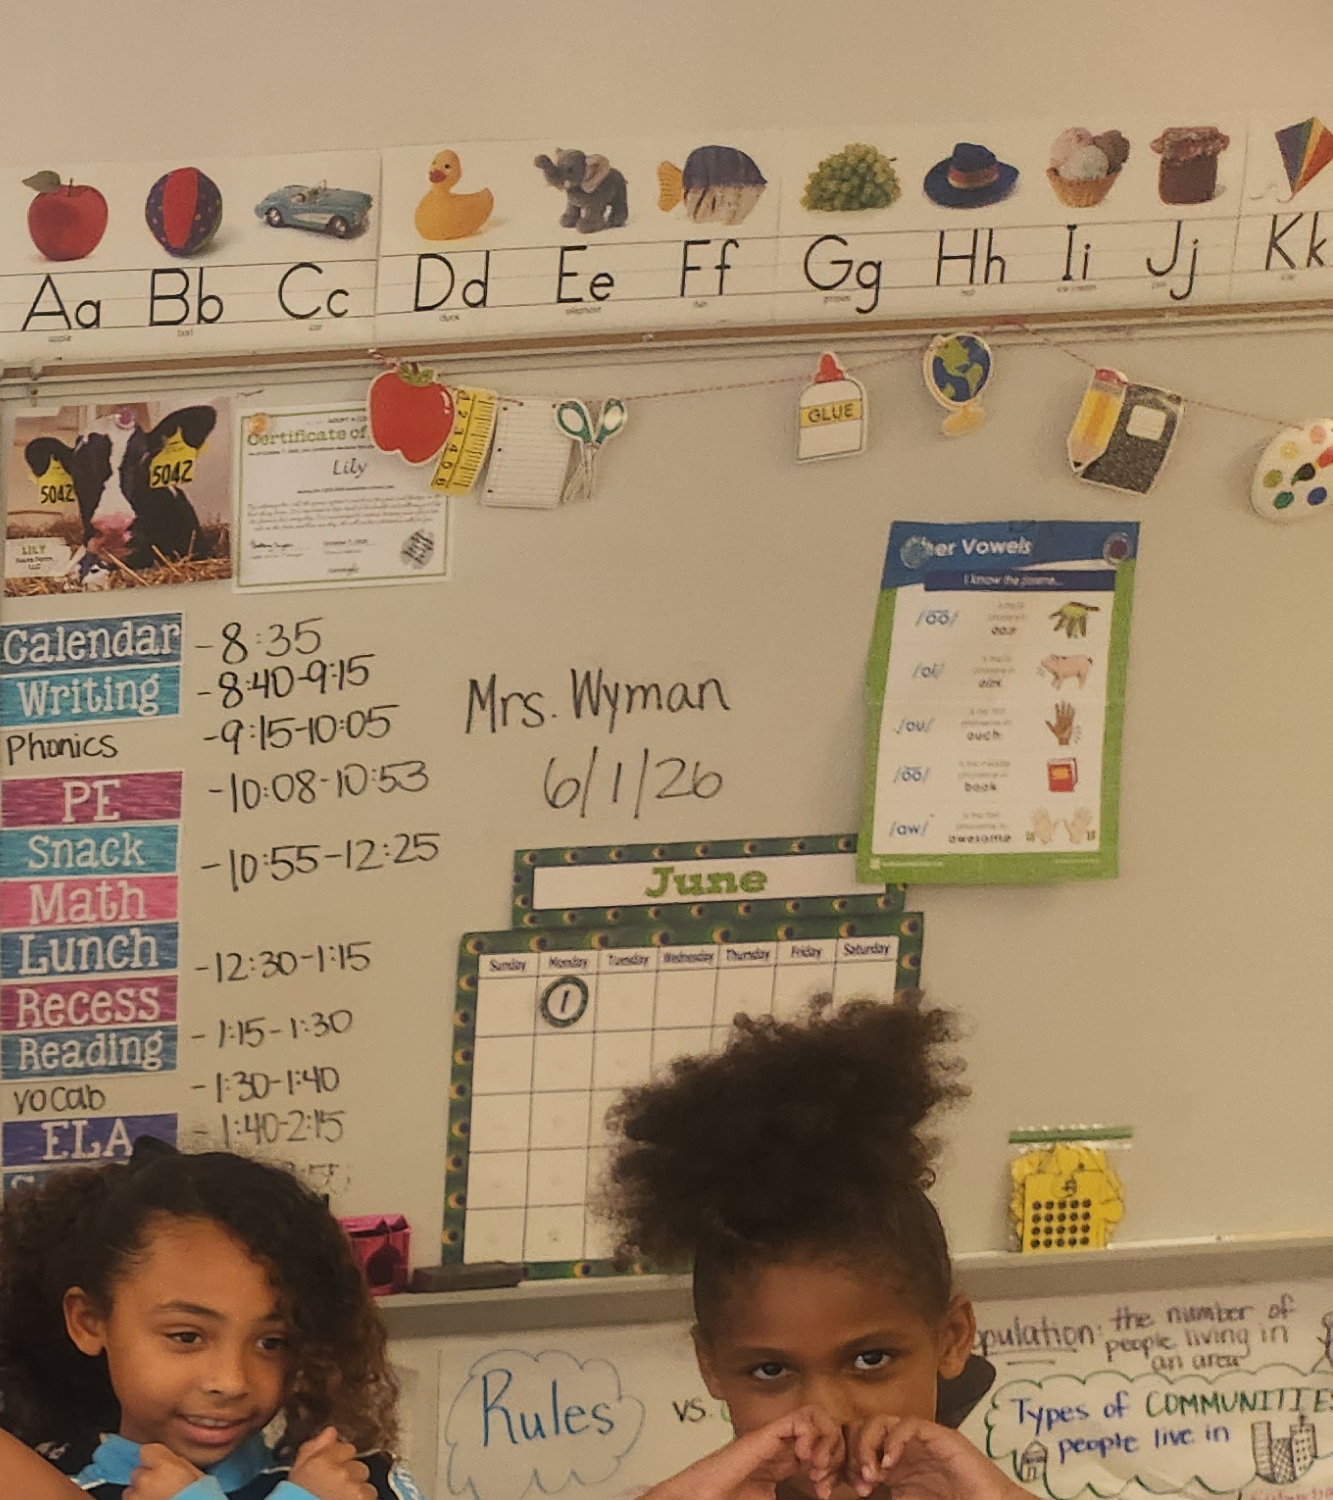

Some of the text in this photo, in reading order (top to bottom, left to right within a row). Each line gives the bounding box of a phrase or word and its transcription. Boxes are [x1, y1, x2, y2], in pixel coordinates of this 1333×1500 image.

[936, 228, 1006, 286] Hh
[1062, 224, 1091, 281] Ii
[1146, 220, 1199, 300] Jj
[1265, 211, 1327, 271] Kk
[413, 250, 490, 312] Dd
[557, 245, 615, 304] Ee
[681, 238, 740, 298] Ff
[804, 234, 882, 314] Gg
[22, 273, 102, 332] Aa
[149, 267, 224, 327] Bb
[278, 262, 350, 320] Cc
[808, 403, 854, 423] GLUE
[152, 460, 194, 485] 5042
[333, 458, 367, 479] Lily
[41, 484, 75, 503] 5042
[962, 536, 1033, 556] Vowels
[3, 623, 180, 665] Calendar
[16, 674, 160, 717] Writing
[465, 669, 731, 734] Mrs. Wyman
[6, 733, 118, 766] Phonics
[63, 779, 121, 823] PE
[542, 746, 724, 819] 6/1/26
[28, 831, 146, 870] Snack
[28, 881, 147, 924] Math
[645, 866, 769, 899] June
[18, 929, 159, 976] Lunch
[490, 958, 527, 974] Sunday
[548, 955, 589, 971] Monday
[790, 945, 822, 960] Friday
[843, 942, 890, 958] Saturday
[16, 986, 161, 1029] Recess
[18, 1030, 164, 1072] Reading
[14, 1085, 106, 1115] vocab
[41, 1119, 134, 1161] ELA
[973, 1293, 1295, 1357] opulation: the number of
[1105, 1335, 1177, 1363] people
[1261, 1322, 1289, 1343] in
[1151, 1355, 1184, 1371] an
[482, 1368, 614, 1447] Rules
[1011, 1387, 1333, 1435] Types of COMMUNITIE
[1058, 1424, 1229, 1464] people live in
